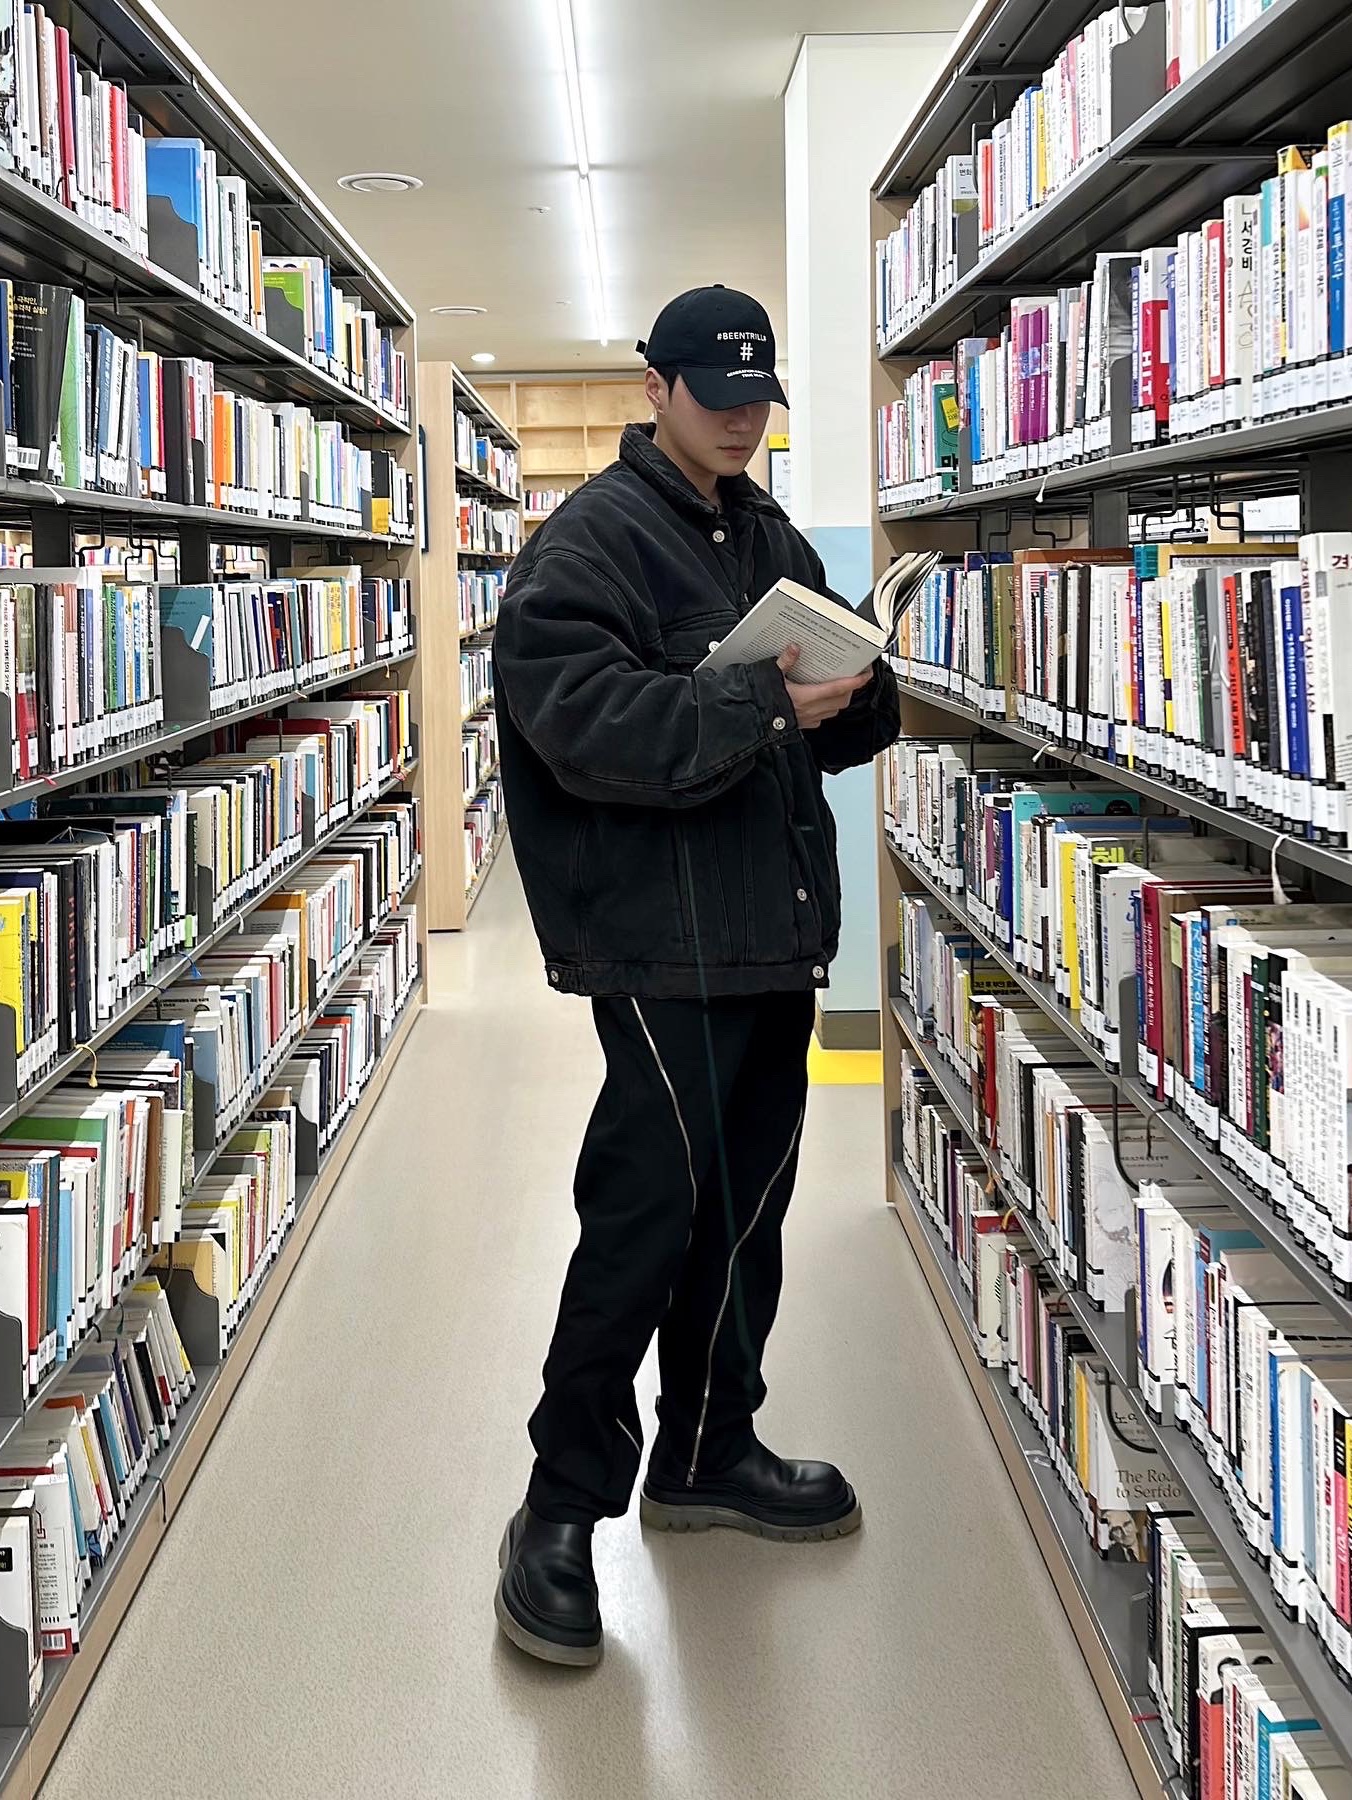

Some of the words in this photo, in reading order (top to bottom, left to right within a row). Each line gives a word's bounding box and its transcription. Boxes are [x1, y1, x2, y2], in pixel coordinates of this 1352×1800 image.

[1142, 351, 1152, 397] HIT
[1115, 1469, 1143, 1483] The
[1116, 1486, 1129, 1498] to
